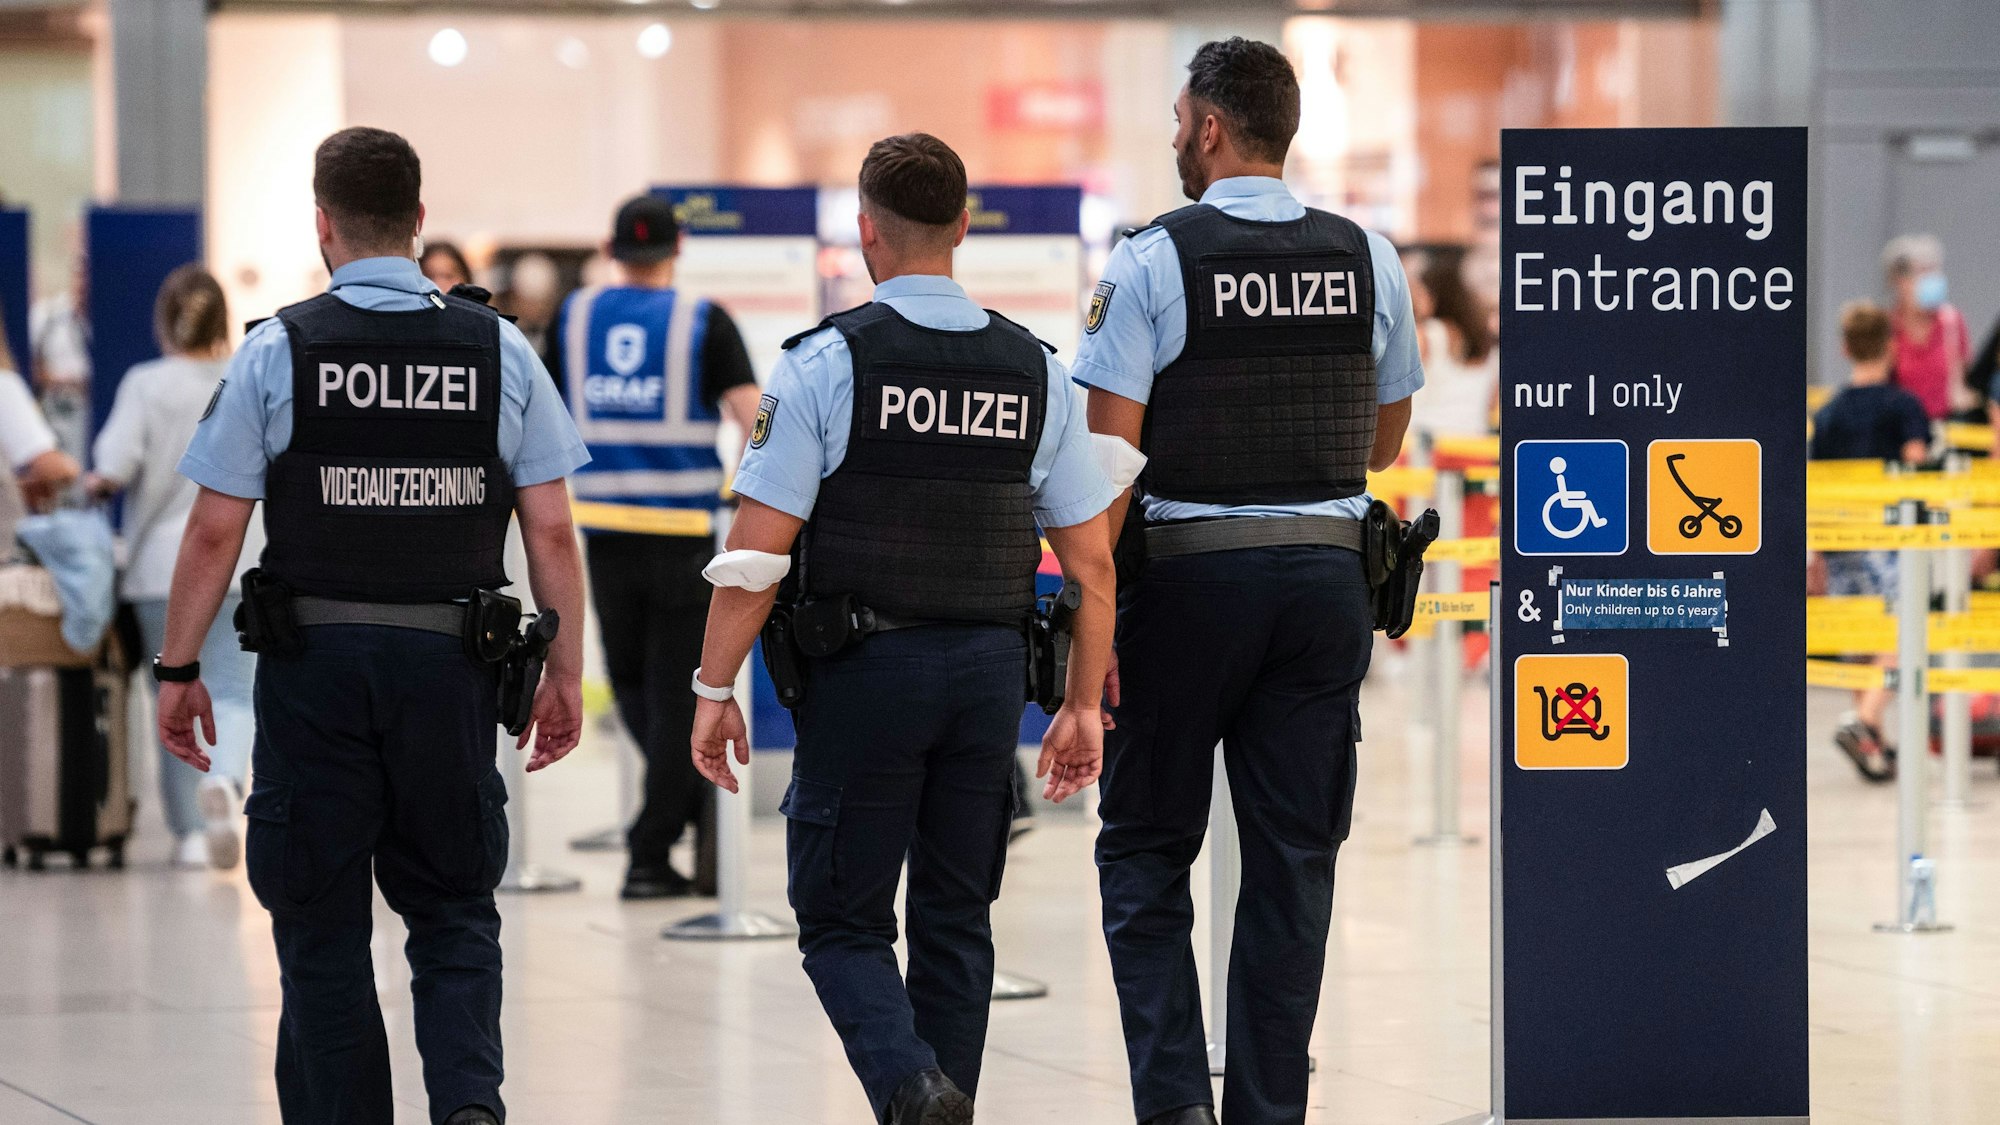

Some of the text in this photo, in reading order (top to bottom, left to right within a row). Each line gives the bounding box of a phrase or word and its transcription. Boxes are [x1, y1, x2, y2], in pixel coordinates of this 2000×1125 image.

[1515, 165, 1773, 241] Eingang
[1214, 271, 1358, 317] POLIZEI
[1515, 252, 1794, 312] Entrance
[318, 362, 477, 411] POLIZEI
[1515, 383, 1573, 408] nur
[1612, 374, 1683, 414] only
[879, 385, 1029, 440] POLIZEI
[320, 466, 486, 507] VIDEOAUFZEICHNUNG
[1517, 589, 1542, 623] &
[1565, 603, 1592, 617] Only
[1594, 603, 1641, 615] children
[1644, 606, 1659, 618] up
[1662, 605, 1675, 616] to
[1677, 604, 1685, 616] 6
[1688, 606, 1719, 618] years
[1566, 583, 1722, 598] Nur Kinder bis 6 Jahre
